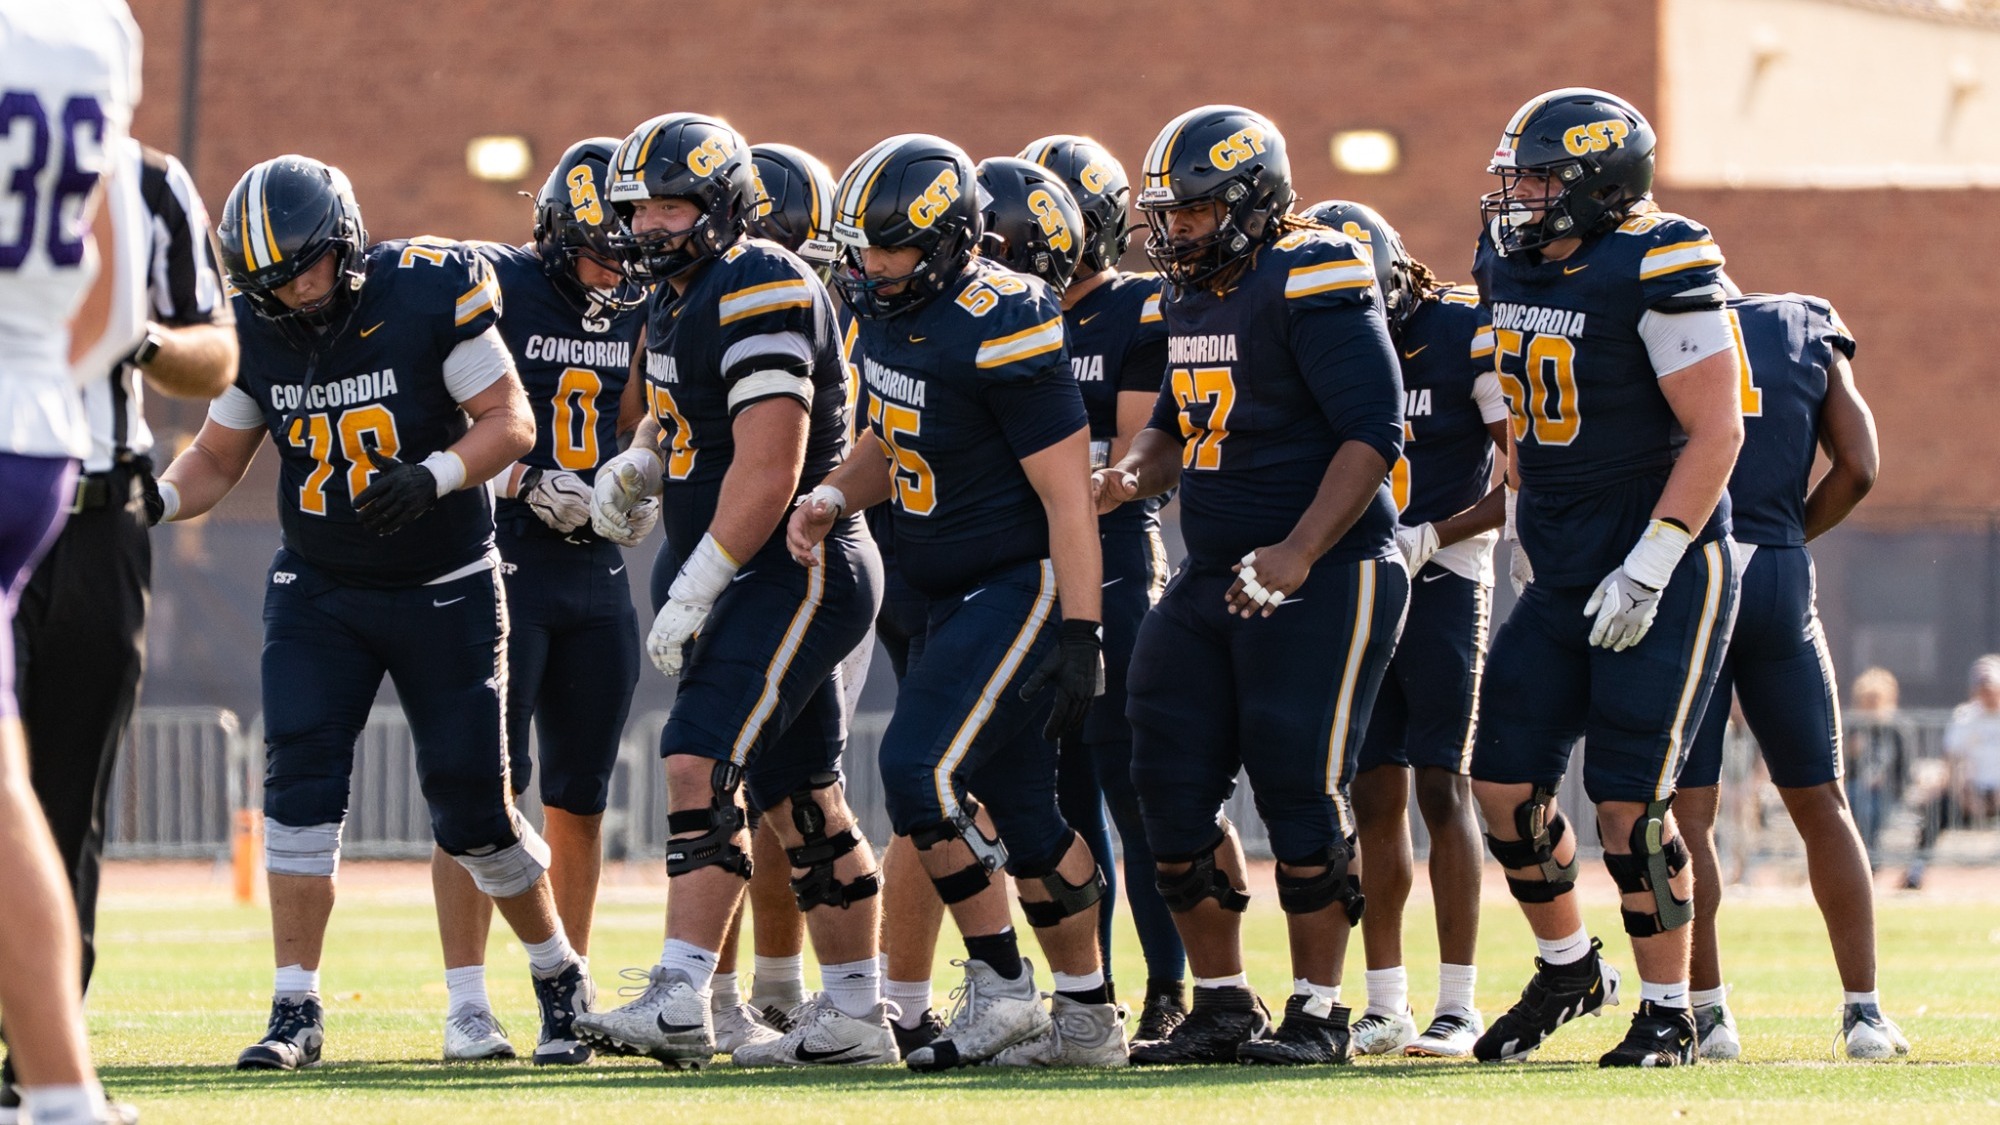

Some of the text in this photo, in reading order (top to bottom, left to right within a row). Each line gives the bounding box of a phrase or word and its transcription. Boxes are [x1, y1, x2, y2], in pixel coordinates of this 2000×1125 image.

[1208, 127, 1268, 172] CSP
[1562, 119, 1630, 157] CSP
[566, 164, 604, 226] CSP
[908, 168, 962, 229] CSP
[1027, 189, 1073, 253] CSP
[1492, 301, 1586, 338] CONCORDIA
[525, 334, 630, 368] CONCORDIA
[1167, 333, 1239, 364] CONCORDIA
[270, 368, 399, 411] CONCORDIA
[1494, 329, 1583, 447] 50
[551, 367, 603, 472] 0
[1170, 366, 1237, 471] 67
[283, 402, 402, 516] 78
[272, 571, 298, 585] CSP
[762, 1004, 797, 1035] NIKE
